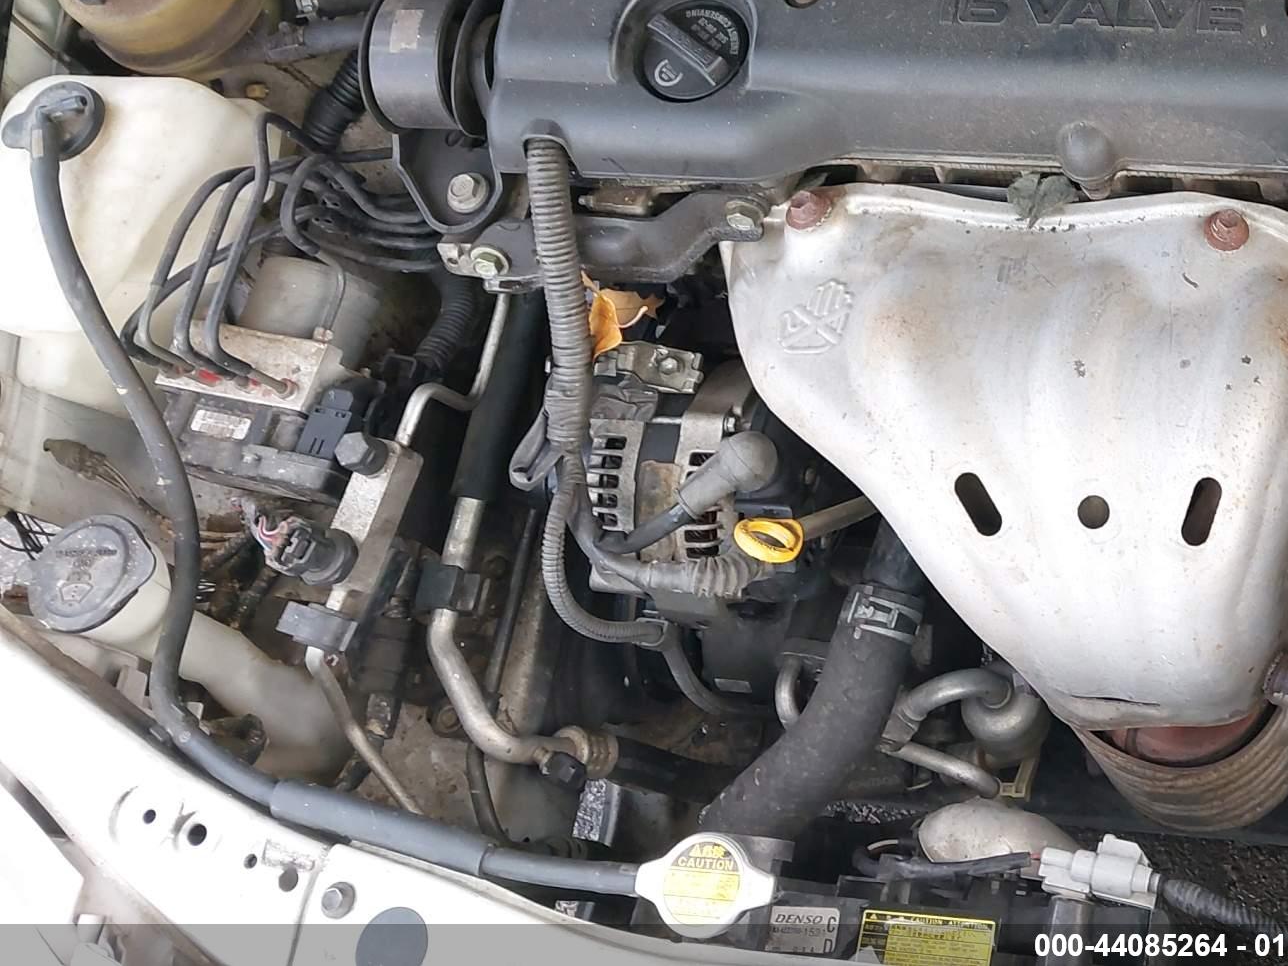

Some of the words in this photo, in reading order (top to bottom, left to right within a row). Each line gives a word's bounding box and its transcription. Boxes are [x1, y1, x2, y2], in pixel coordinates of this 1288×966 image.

[677, 857, 734, 872] CAUTION
[775, 913, 824, 924] DENSO
[826, 916, 836, 933] C
